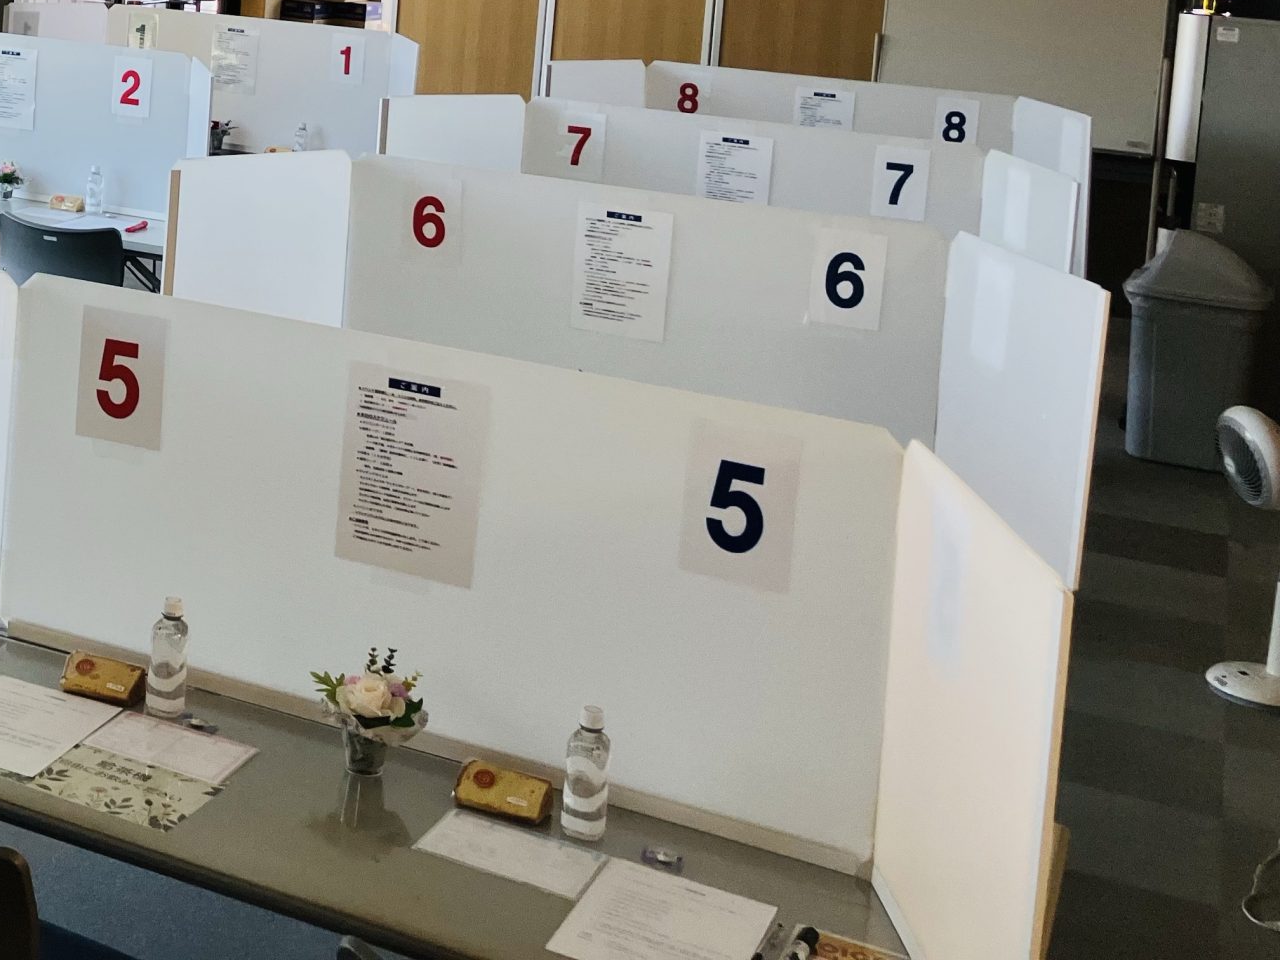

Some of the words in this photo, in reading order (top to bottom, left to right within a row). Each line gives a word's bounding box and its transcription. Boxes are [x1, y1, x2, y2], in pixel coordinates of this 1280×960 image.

[339, 46, 352, 76] 1
[119, 69, 141, 106] 2
[677, 82, 700, 114] 8
[567, 125, 593, 167] 7
[942, 110, 968, 143] 8
[885, 161, 915, 206] 7
[411, 195, 446, 249] 6
[825, 252, 867, 309] 6
[96, 338, 140, 420] 5
[705, 459, 767, 554] 5
